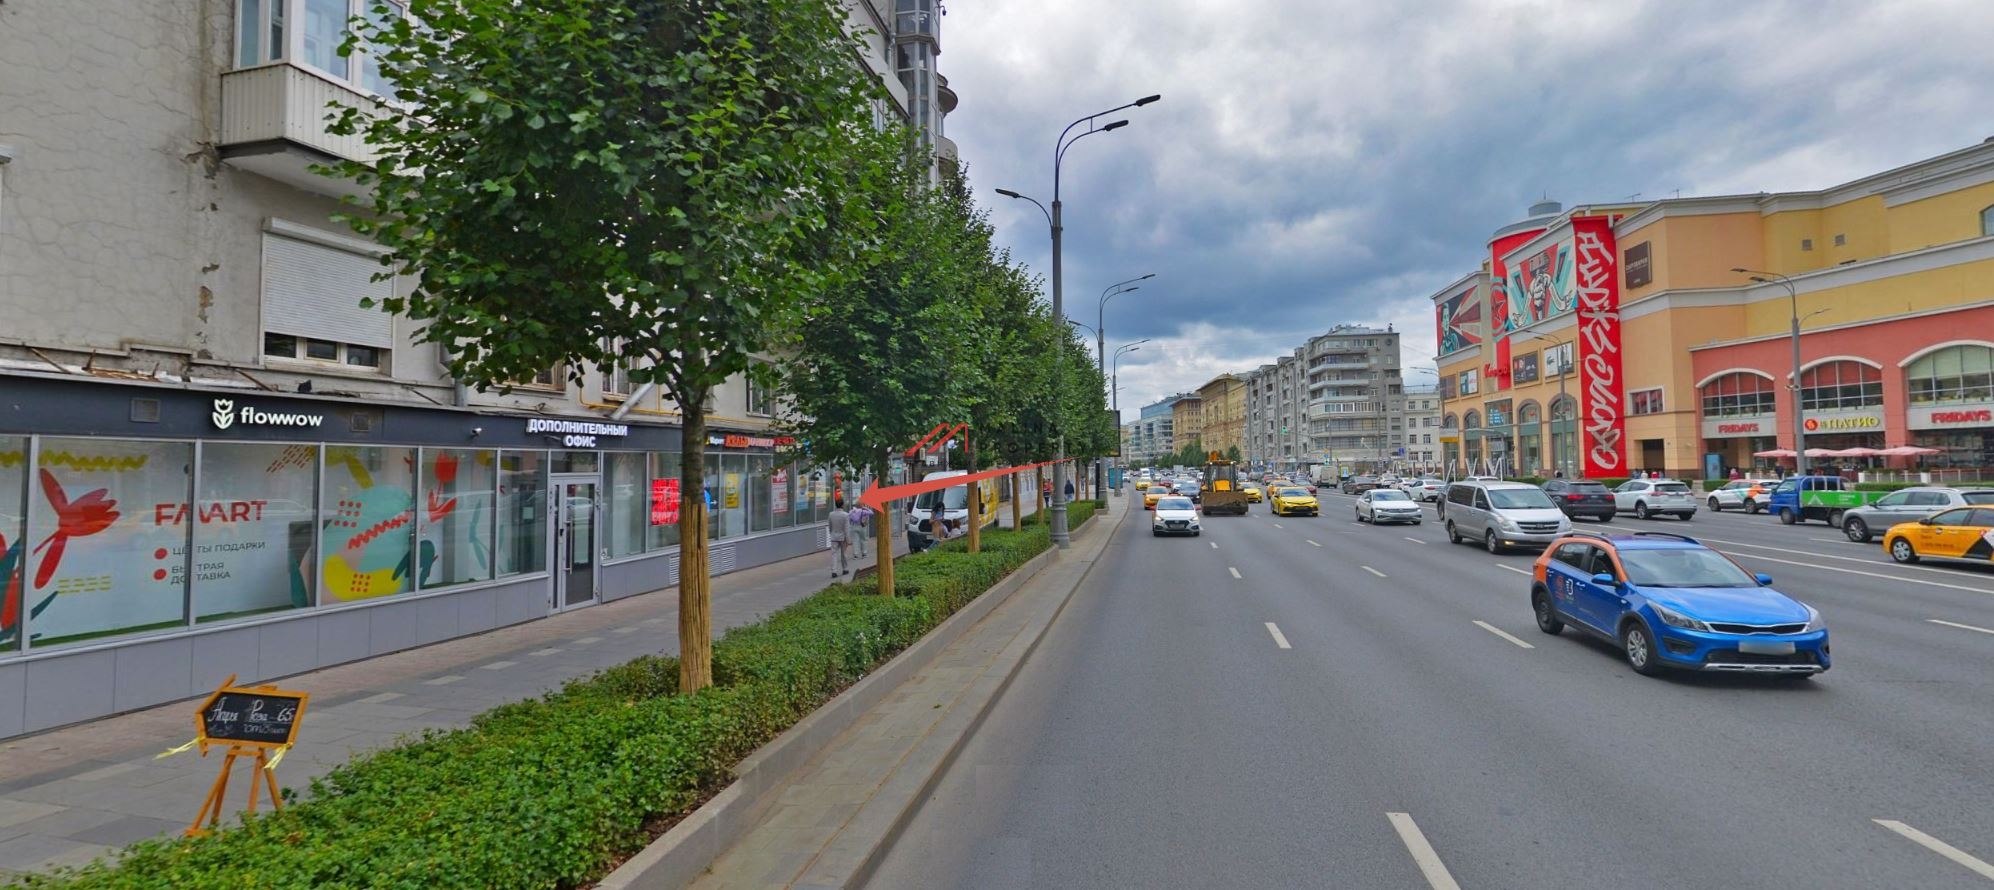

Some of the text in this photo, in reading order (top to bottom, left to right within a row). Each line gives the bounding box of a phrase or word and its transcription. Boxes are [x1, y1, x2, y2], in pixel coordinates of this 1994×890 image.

[240, 406, 323, 427] flowwow
[563, 435, 597, 448] ОФИС
[173, 541, 266, 555] ЦТЫ ПОДАРКИ
[170, 571, 231, 585] ДОТАВКА
